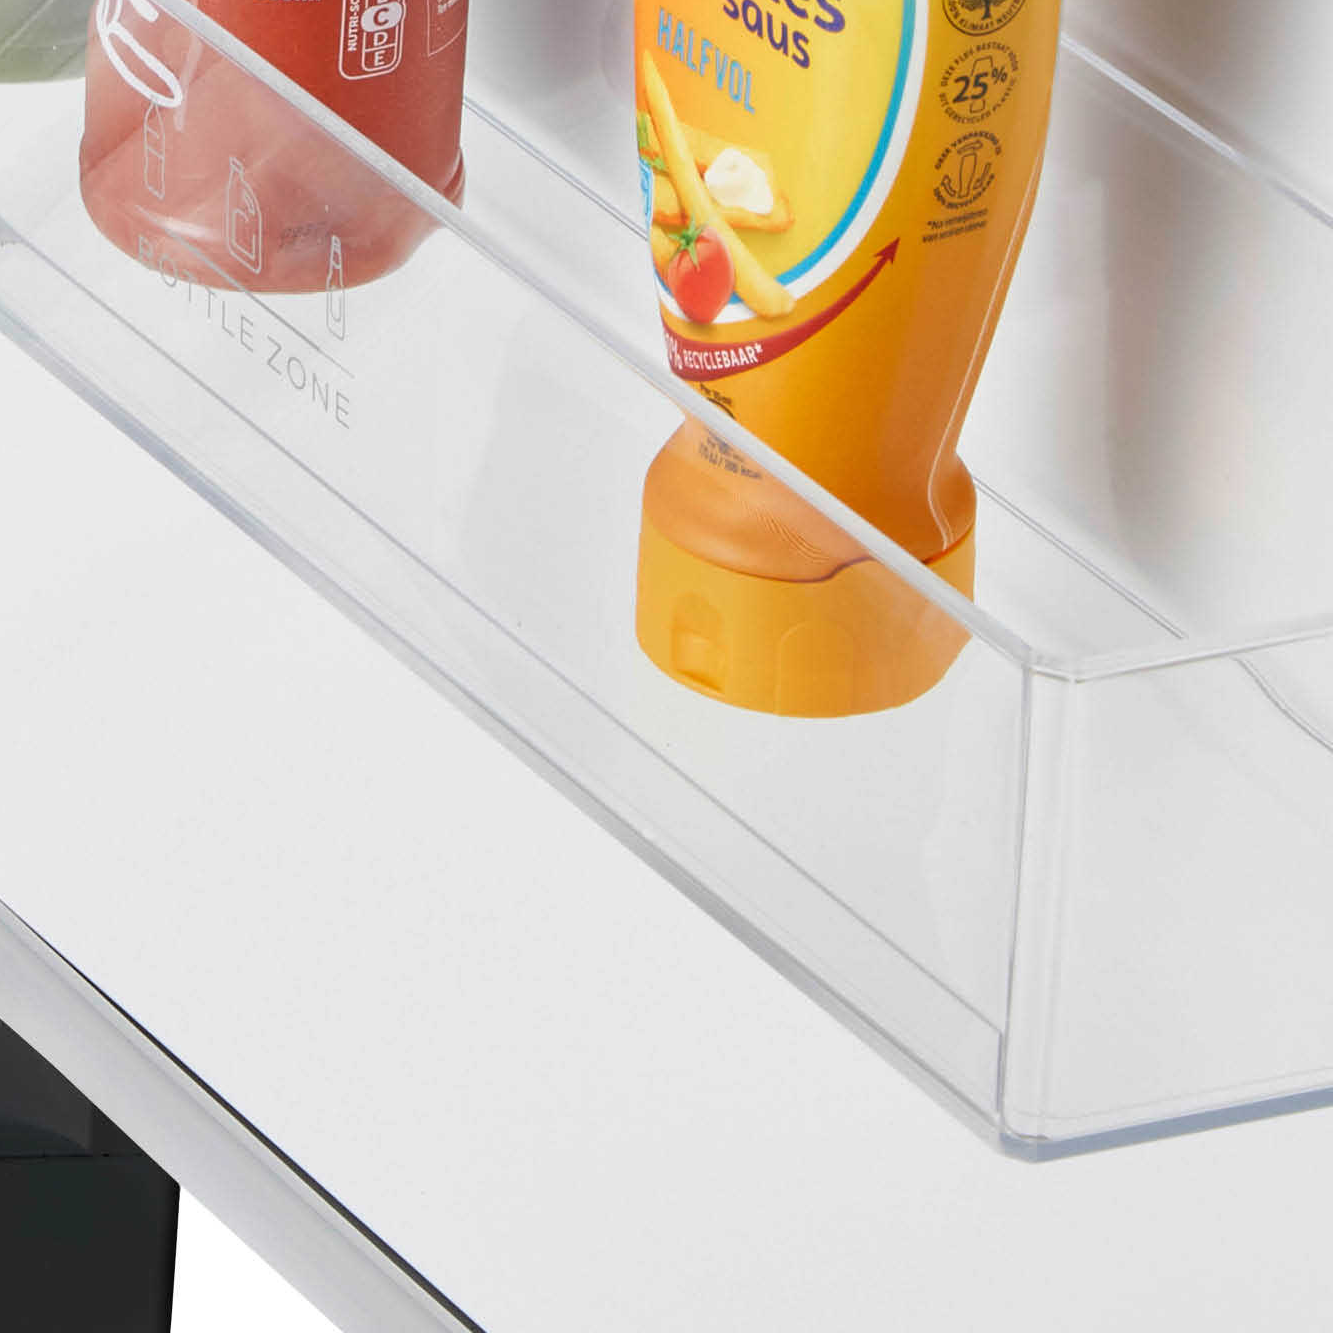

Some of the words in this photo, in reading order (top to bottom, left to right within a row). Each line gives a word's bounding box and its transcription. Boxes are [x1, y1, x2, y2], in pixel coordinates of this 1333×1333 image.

[372, 7, 389, 31] C
[373, 31, 386, 47] D
[373, 49, 386, 68] E
[657, 6, 756, 115] HALFVOL
[952, 66, 1009, 104] 25%
[138, 234, 254, 354] BOTTLE
[267, 334, 350, 430] ZONE
